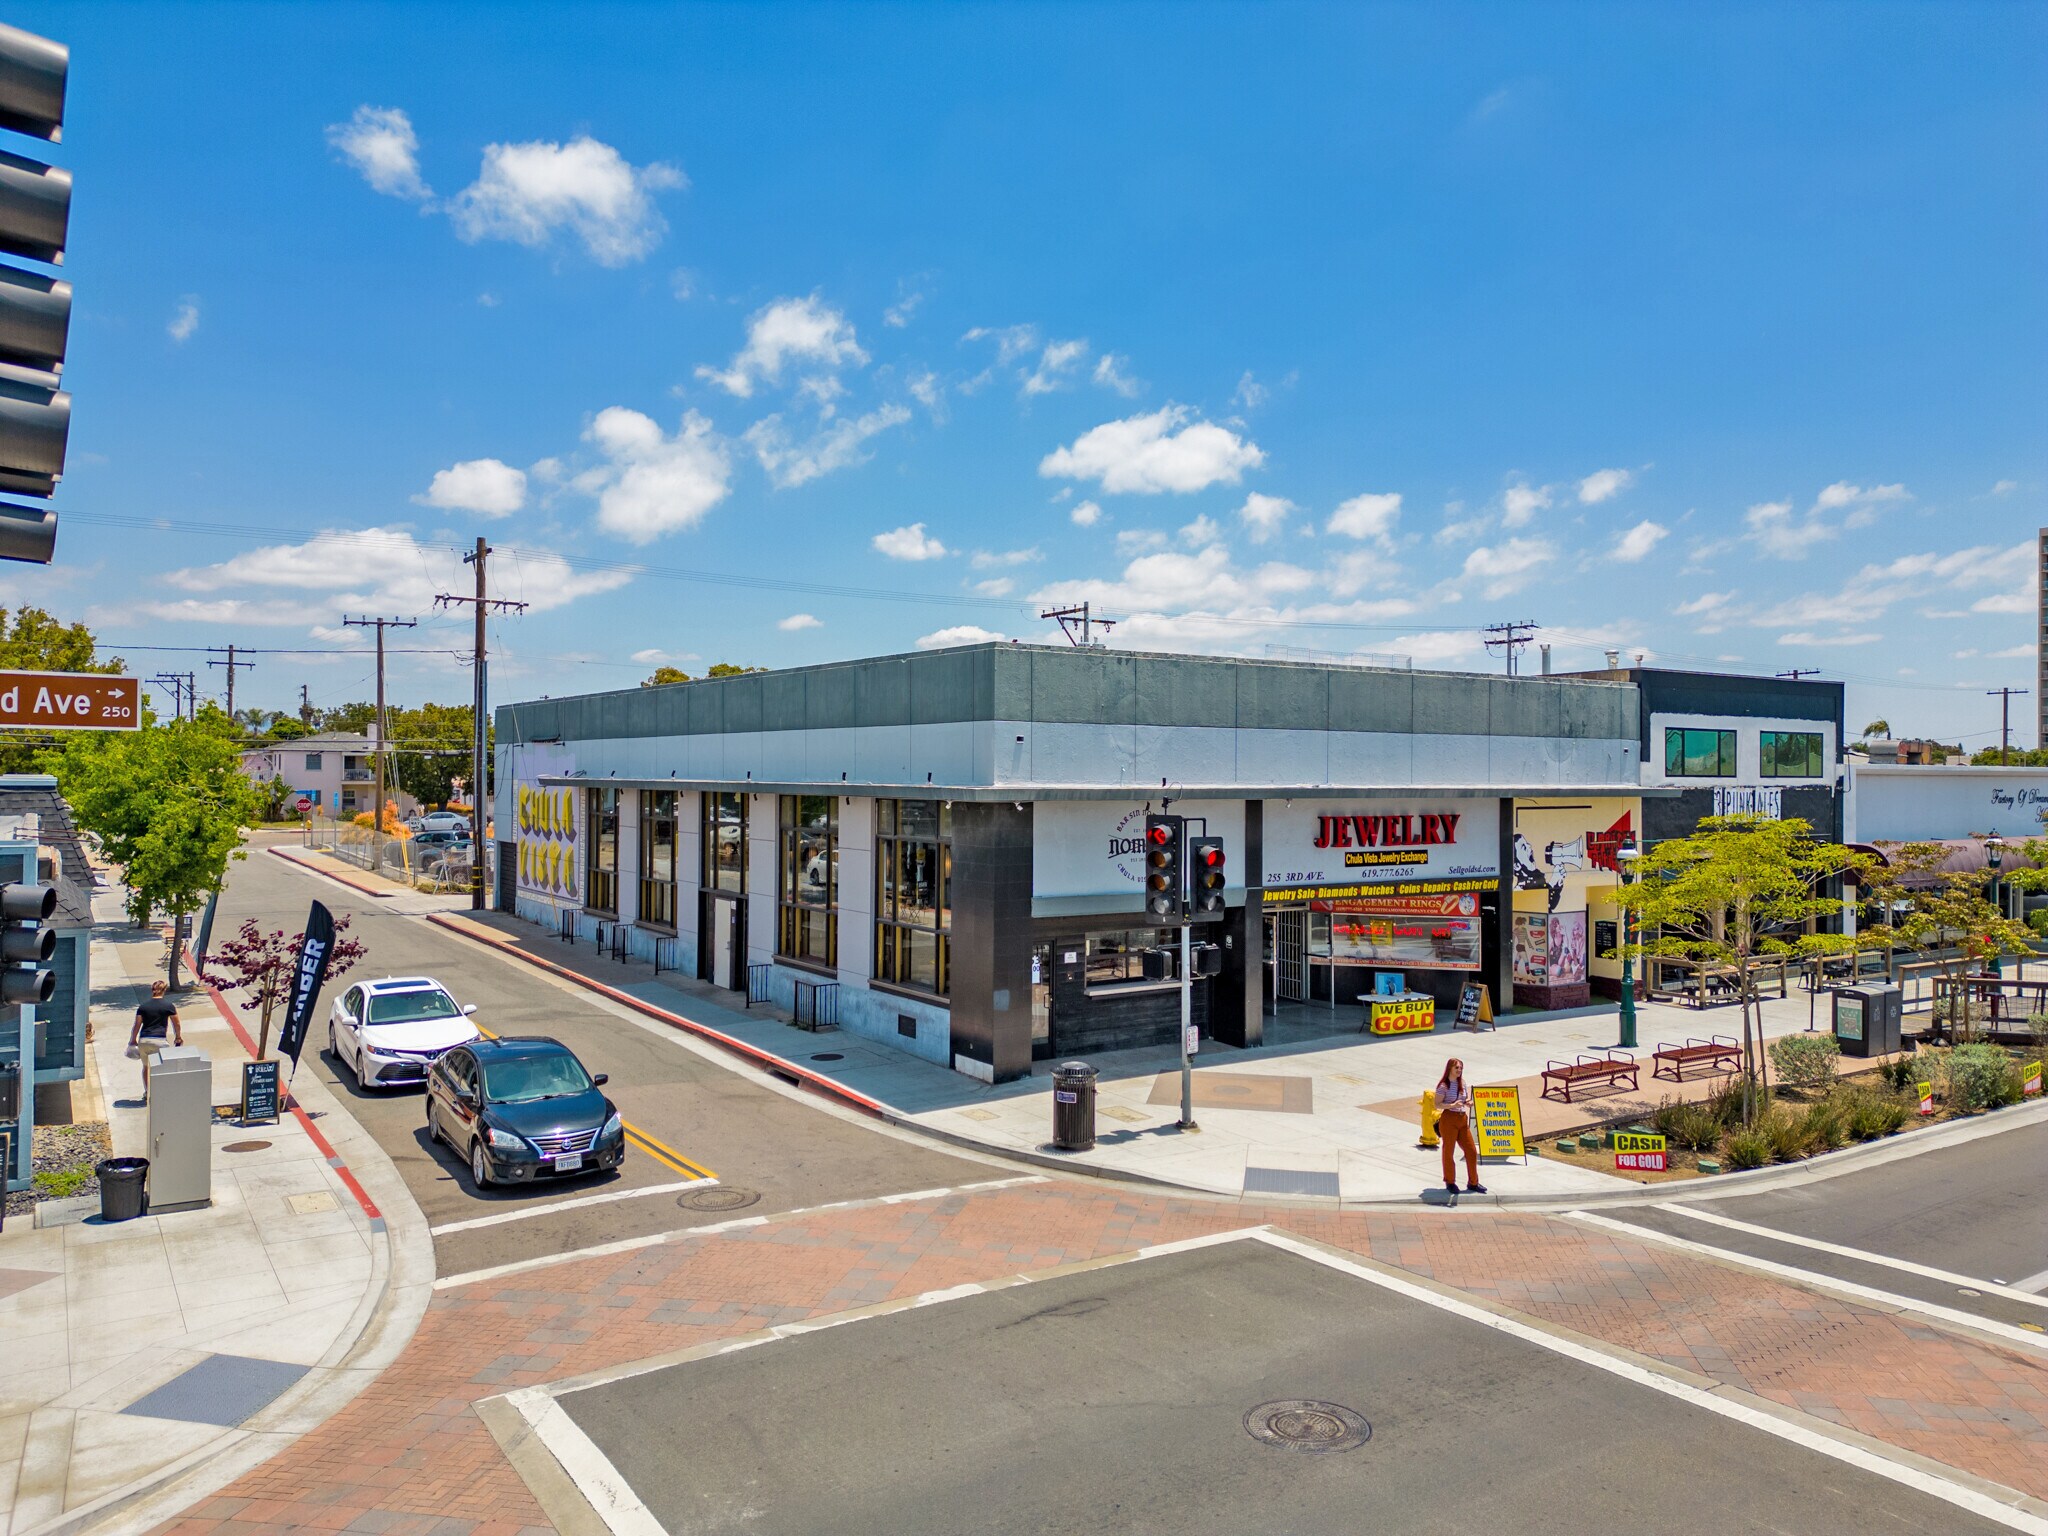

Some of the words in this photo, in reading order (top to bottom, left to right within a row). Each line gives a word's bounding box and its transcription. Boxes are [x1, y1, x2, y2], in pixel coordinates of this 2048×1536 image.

[33, 687, 91, 715] Ave
[102, 706, 131, 718] 250
[296, 802, 312, 810] STOP
[518, 783, 577, 844] CHULA
[1314, 815, 1460, 848] JEWELRY
[1345, 853, 1363, 865] Chula
[1363, 852, 1378, 864] Vista
[1379, 851, 1401, 864] Jewelry
[1400, 850, 1428, 864] Exchange
[518, 836, 578, 898] VISTA
[1362, 867, 1414, 878] 619.777.6265
[1448, 865, 1496, 876] Sellgoldsd.com
[1267, 873, 1281, 883] 255
[1285, 872, 1304, 882] 3RD
[1304, 871, 1326, 881] AVE.
[1263, 889, 1297, 902] Jewelry
[1297, 888, 1315, 899] Sale
[1318, 886, 1358, 899] Diamonds
[1361, 885, 1395, 897] Watches
[1399, 884, 1420, 894] Coins
[1422, 882, 1451, 894] Repairs
[1453, 880, 1471, 891] Cash
[1471, 880, 1482, 890] For
[1482, 879, 1499, 891] Gold
[1334, 898, 1408, 908] ENGAGEMENT
[1410, 899, 1442, 908] RINGS
[1380, 1004, 1402, 1014] WE
[1405, 1001, 1432, 1012] BUY
[1375, 1012, 1434, 1032] GOLD
[2025, 1064, 2041, 1080] CASH
[1501, 1090, 1515, 1098] Gold
[1485, 1109, 1511, 1118] Jewelry
[1492, 1139, 1511, 1147] Coins
[1617, 1135, 1662, 1150] CASH
[1618, 1155, 1637, 1167] FOR
[1638, 1154, 1664, 1170] GOLD
